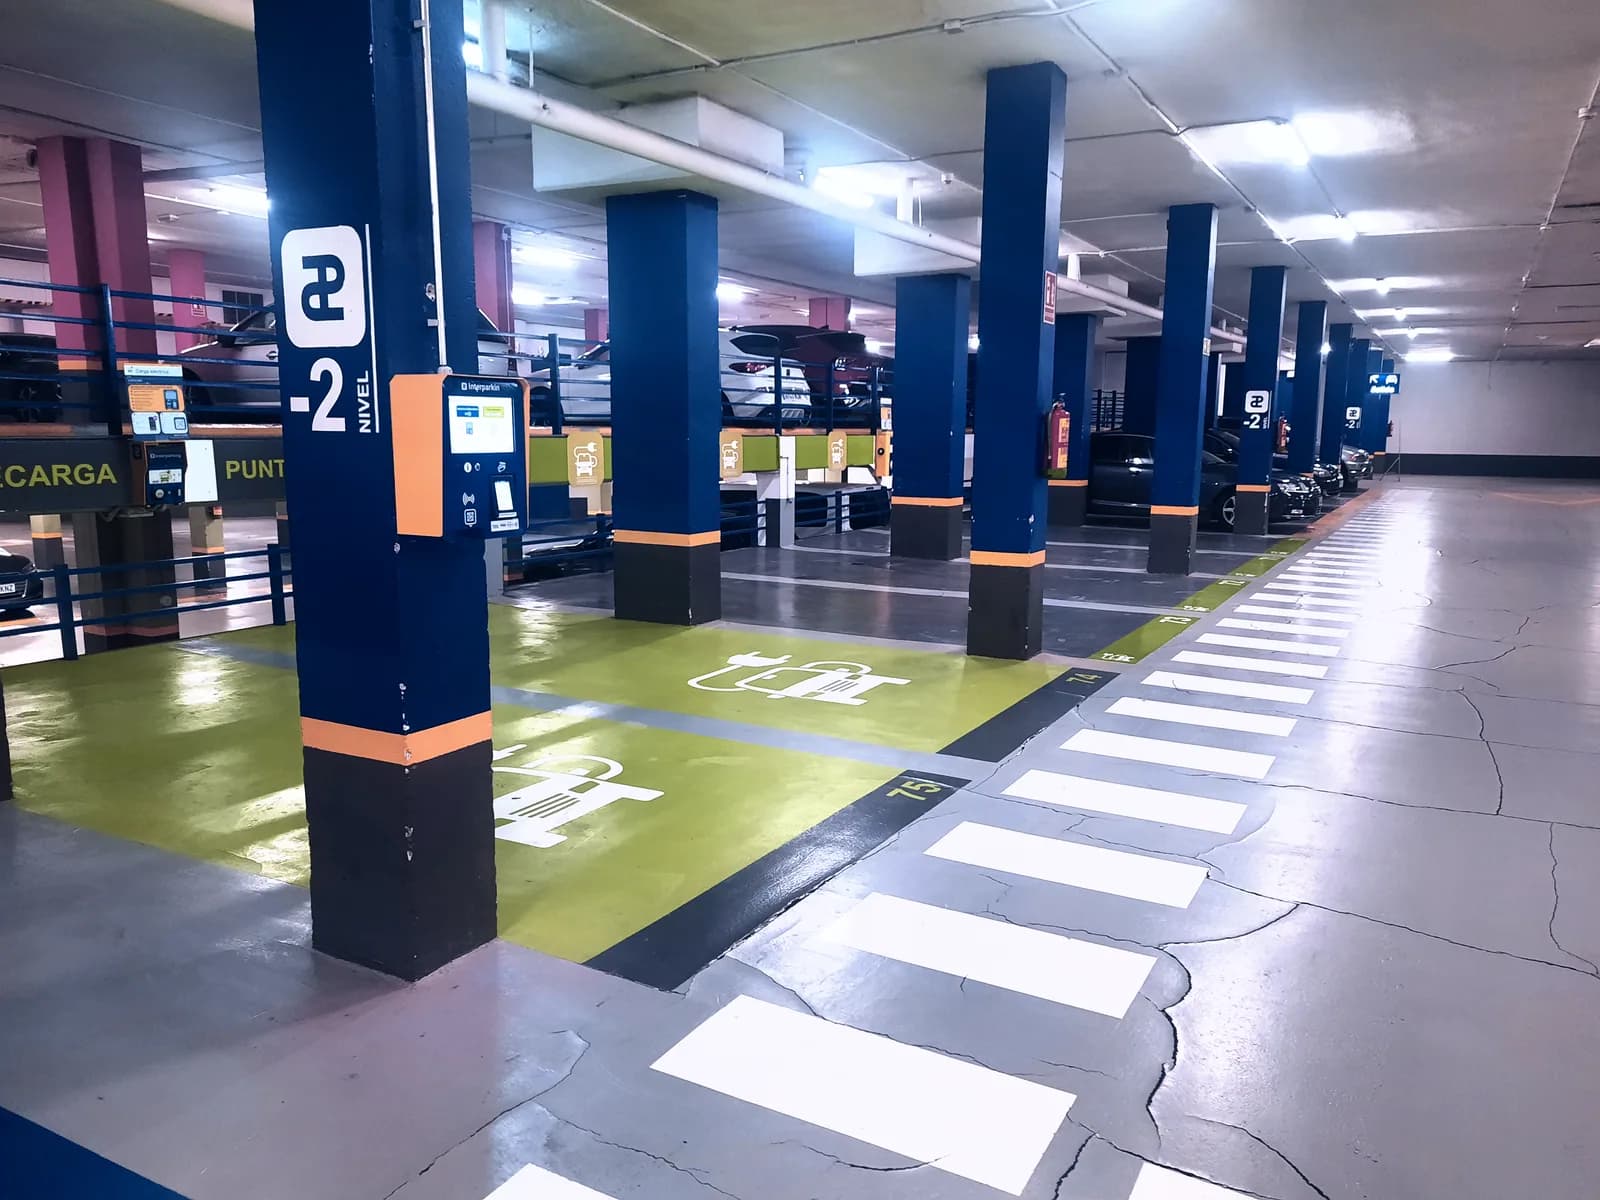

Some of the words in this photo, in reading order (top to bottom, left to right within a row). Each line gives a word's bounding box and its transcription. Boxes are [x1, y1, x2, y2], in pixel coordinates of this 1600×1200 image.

[290, 357, 346, 432] -2
[357, 370, 371, 433] NIVEL
[1243, 414, 1261, 429] -2
[1344, 420, 1356, 429] -2
[0, 463, 118, 489] CARGA
[1066, 672, 1102, 684] 74
[886, 780, 942, 801] 75
